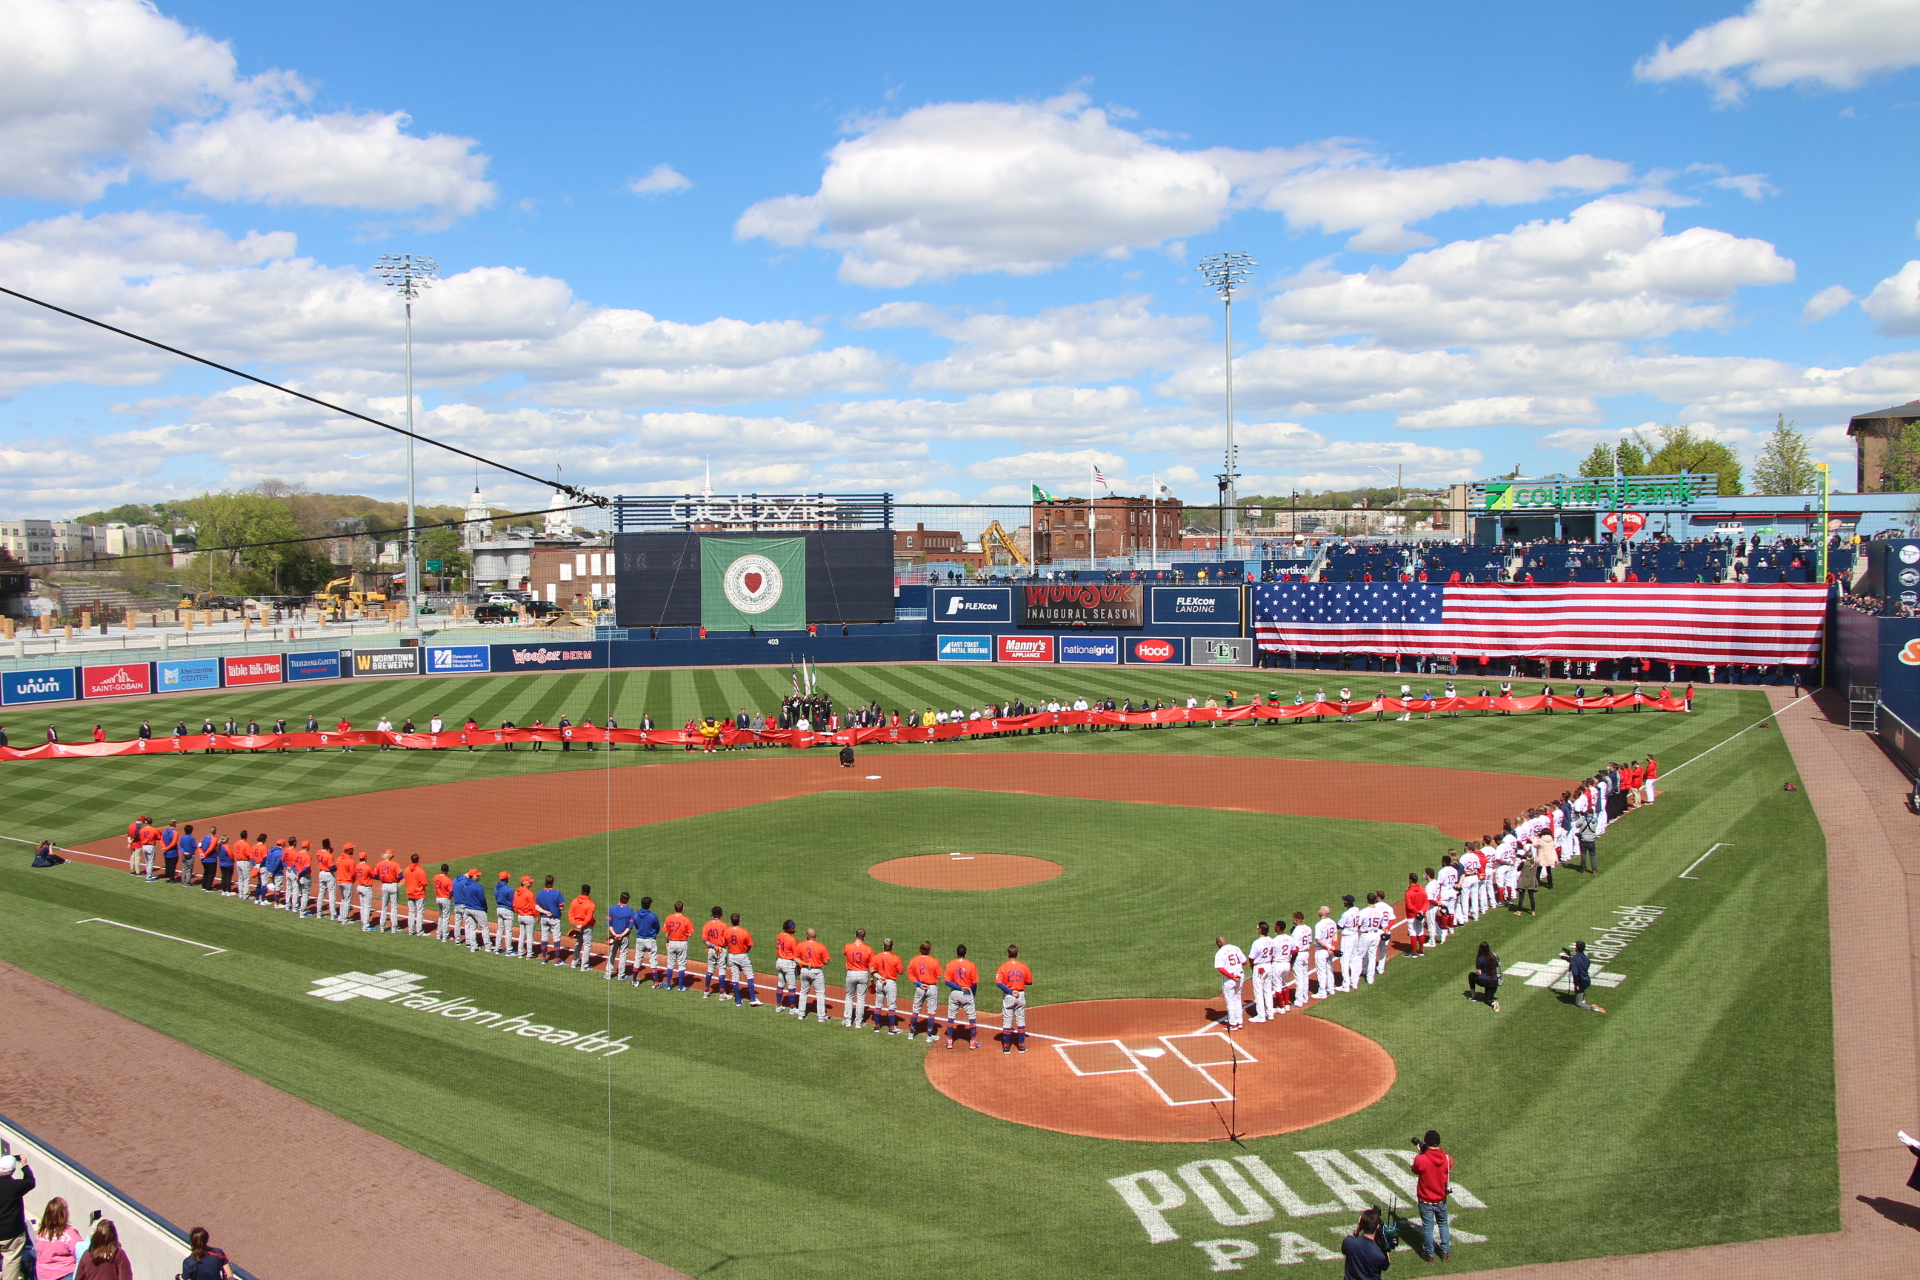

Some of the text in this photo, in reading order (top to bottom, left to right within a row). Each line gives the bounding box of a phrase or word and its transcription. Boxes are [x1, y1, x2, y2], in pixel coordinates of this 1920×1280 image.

[671, 492, 838, 522] abbvie
[1607, 513, 1642, 526] HAPOON
[1817, 531, 1825, 567] POLE
[1027, 608, 1135, 619] INAUGURAL SEASON
[1175, 605, 1215, 613] LANDING
[1005, 639, 1046, 653] Manny's
[1063, 644, 1114, 656] nationalgrid
[1139, 645, 1169, 657] Hood
[372, 653, 414, 663] WORMTOWN
[512, 647, 592, 665] WooSox BERM
[228, 663, 280, 677] Table Talk Pies
[372, 661, 408, 670] BREWERY
[182, 674, 209, 682] CENTER
[17, 677, 59, 695] unum
[91, 682, 143, 693] SAINT-GOBAIN
[669, 921, 681, 932] 27
[1368, 917, 1380, 928] 15
[708, 928, 718, 939] 40
[730, 935, 738, 945] 8
[805, 947, 812, 959] 3
[1282, 944, 1289, 956] 2
[851, 952, 862, 964] 13
[1228, 953, 1241, 966] 51
[919, 963, 926, 975] 2
[1193, 1214, 1488, 1272] PAK
